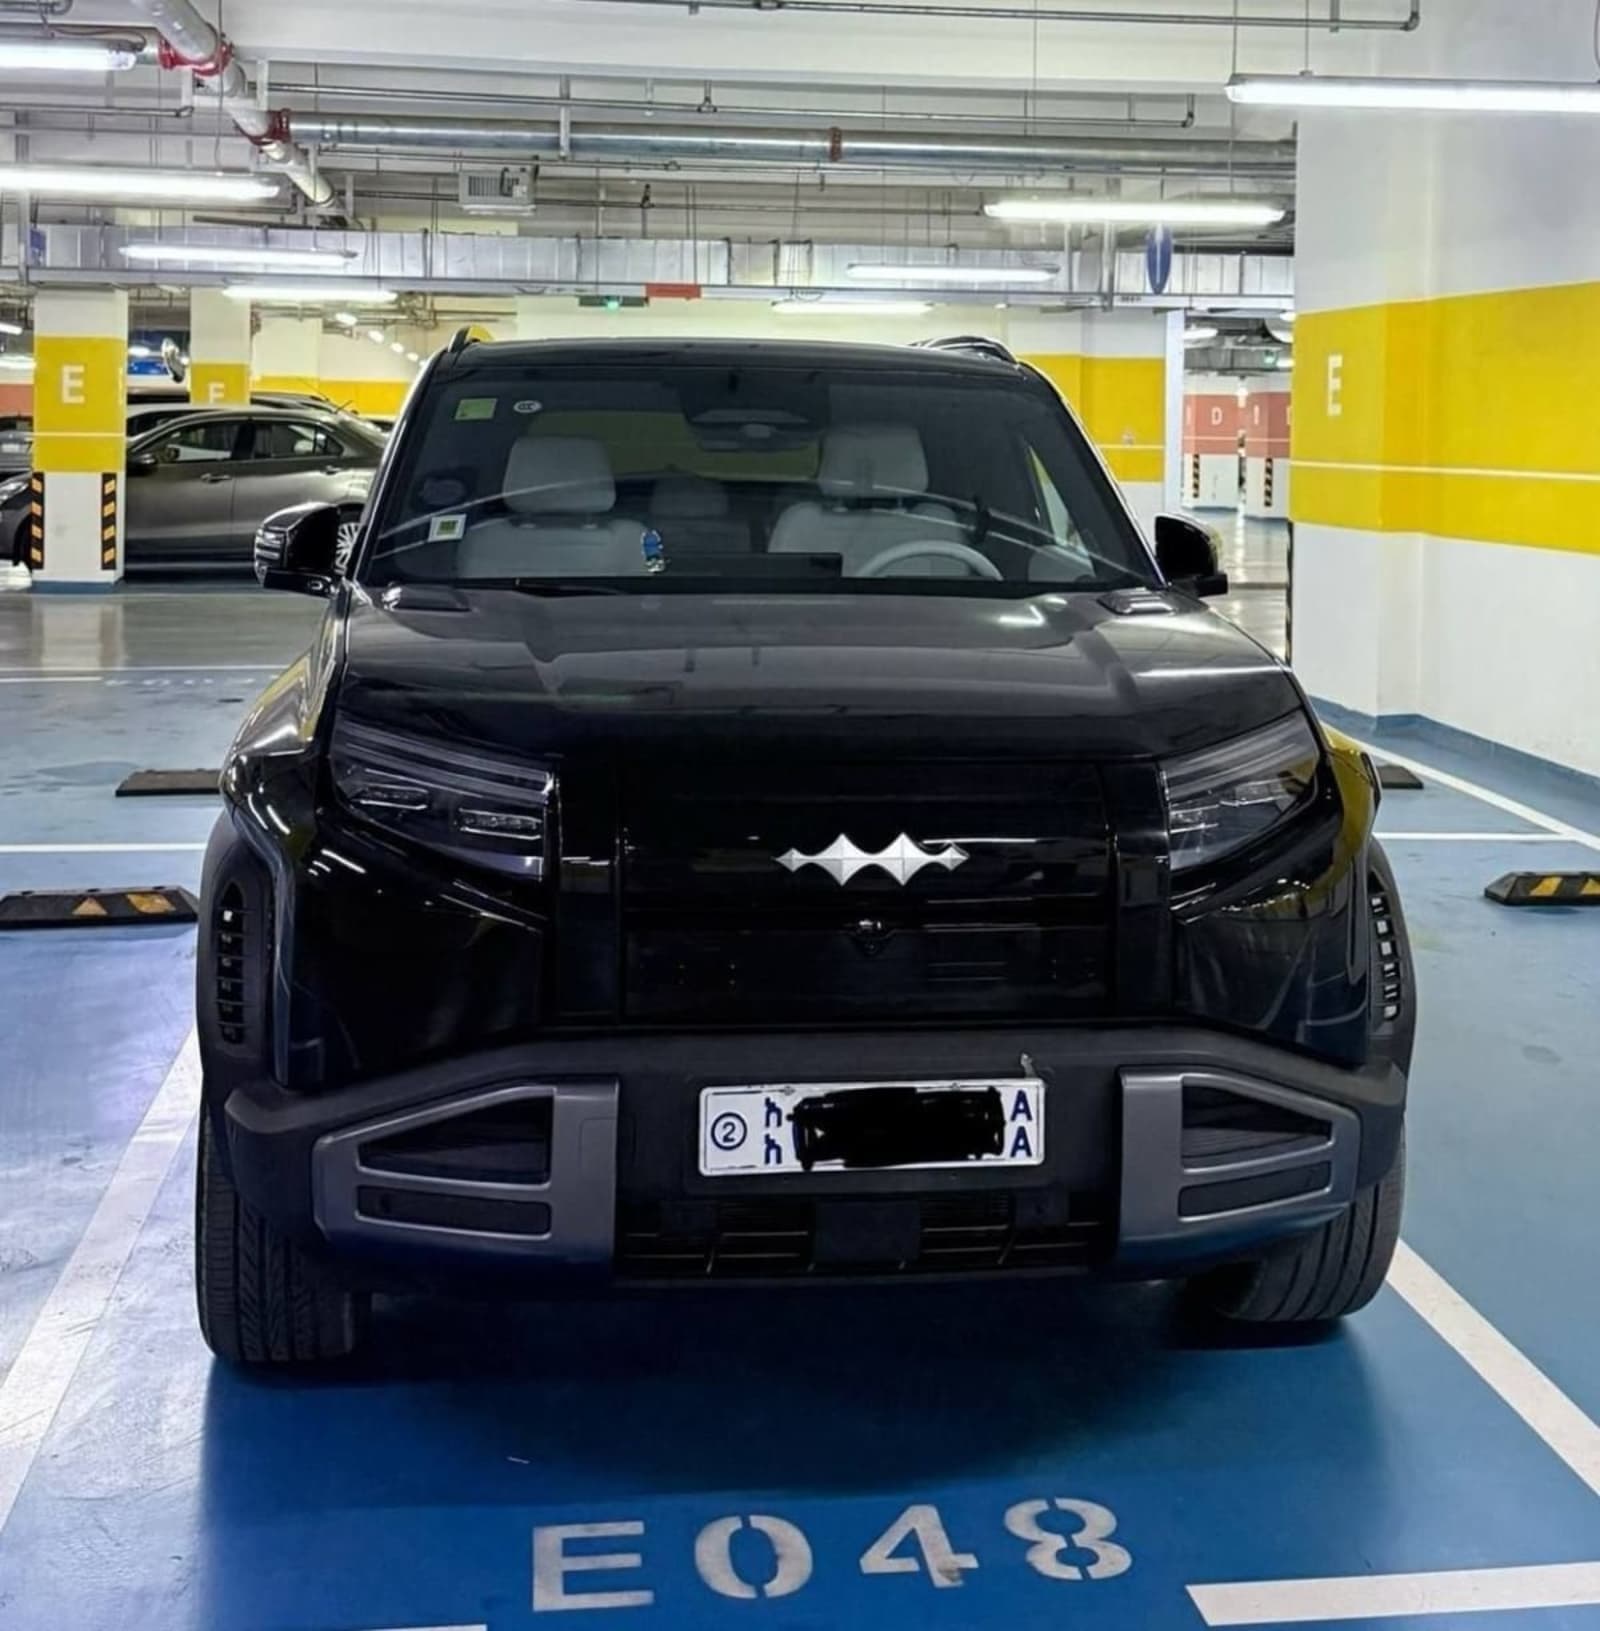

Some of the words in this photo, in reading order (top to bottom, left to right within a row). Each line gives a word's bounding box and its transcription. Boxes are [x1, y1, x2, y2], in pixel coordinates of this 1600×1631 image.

[61, 364, 85, 404] E
[1327, 354, 1343, 416] E
[1211, 406, 1222, 425] D
[1010, 1089, 1033, 1122] A
[1010, 1125, 1033, 1158] A
[532, 1497, 1133, 1613] E048
